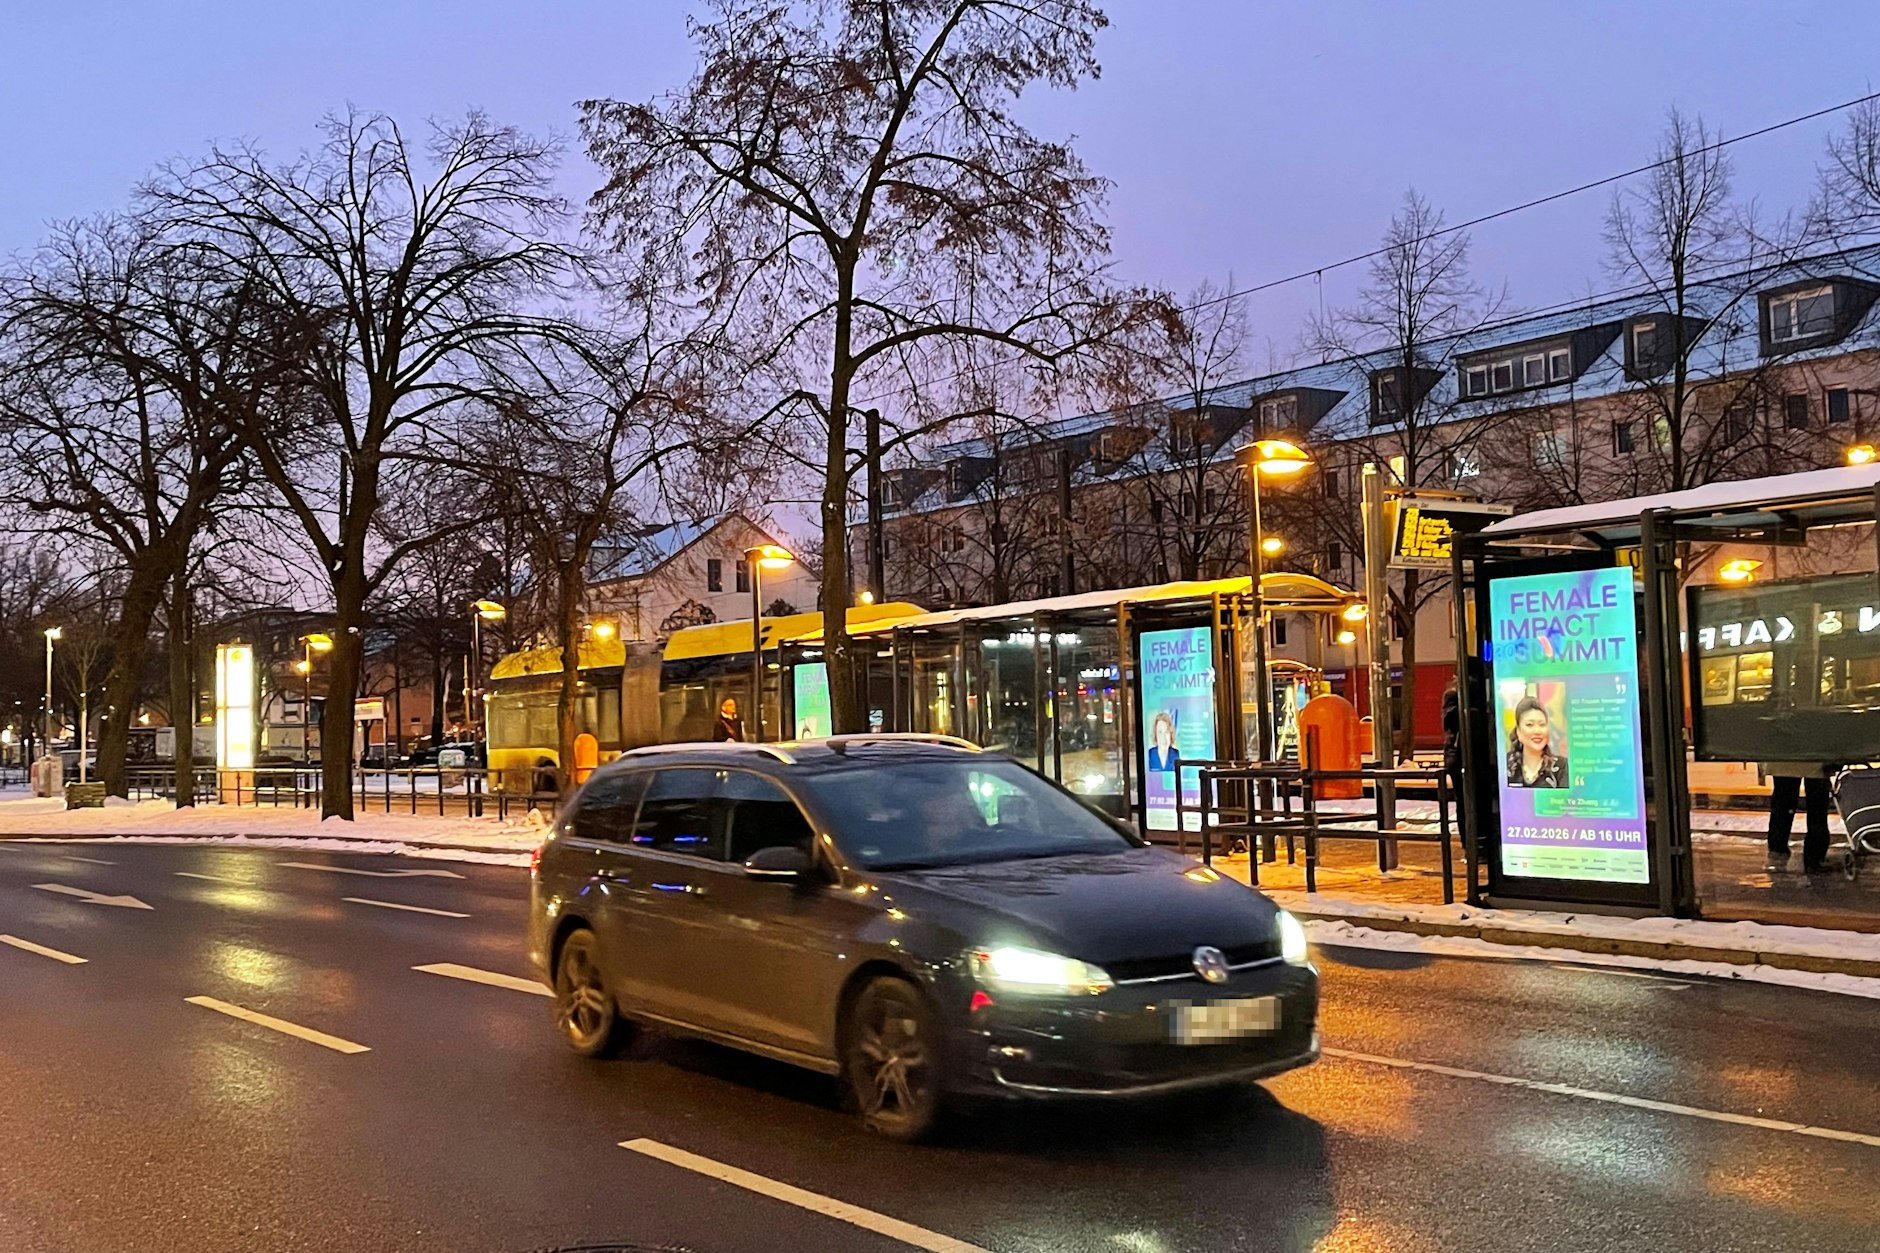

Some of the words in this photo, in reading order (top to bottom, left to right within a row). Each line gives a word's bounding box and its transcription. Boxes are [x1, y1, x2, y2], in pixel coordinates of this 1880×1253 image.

[1510, 584, 1617, 614] FEMALE
[1500, 612, 1600, 641] IMPACT
[1151, 638, 1206, 656] FEMALE
[1514, 637, 1626, 665] SUMMIT
[1145, 656, 1195, 674] IMPACT
[1153, 672, 1210, 690] SUMMIT
[1507, 826, 1570, 840] 27.02.2026
[1571, 828, 1578, 840] /
[1579, 829, 1596, 841] AB
[1598, 830, 1613, 842] 16
[1615, 830, 1642, 843] UHR
